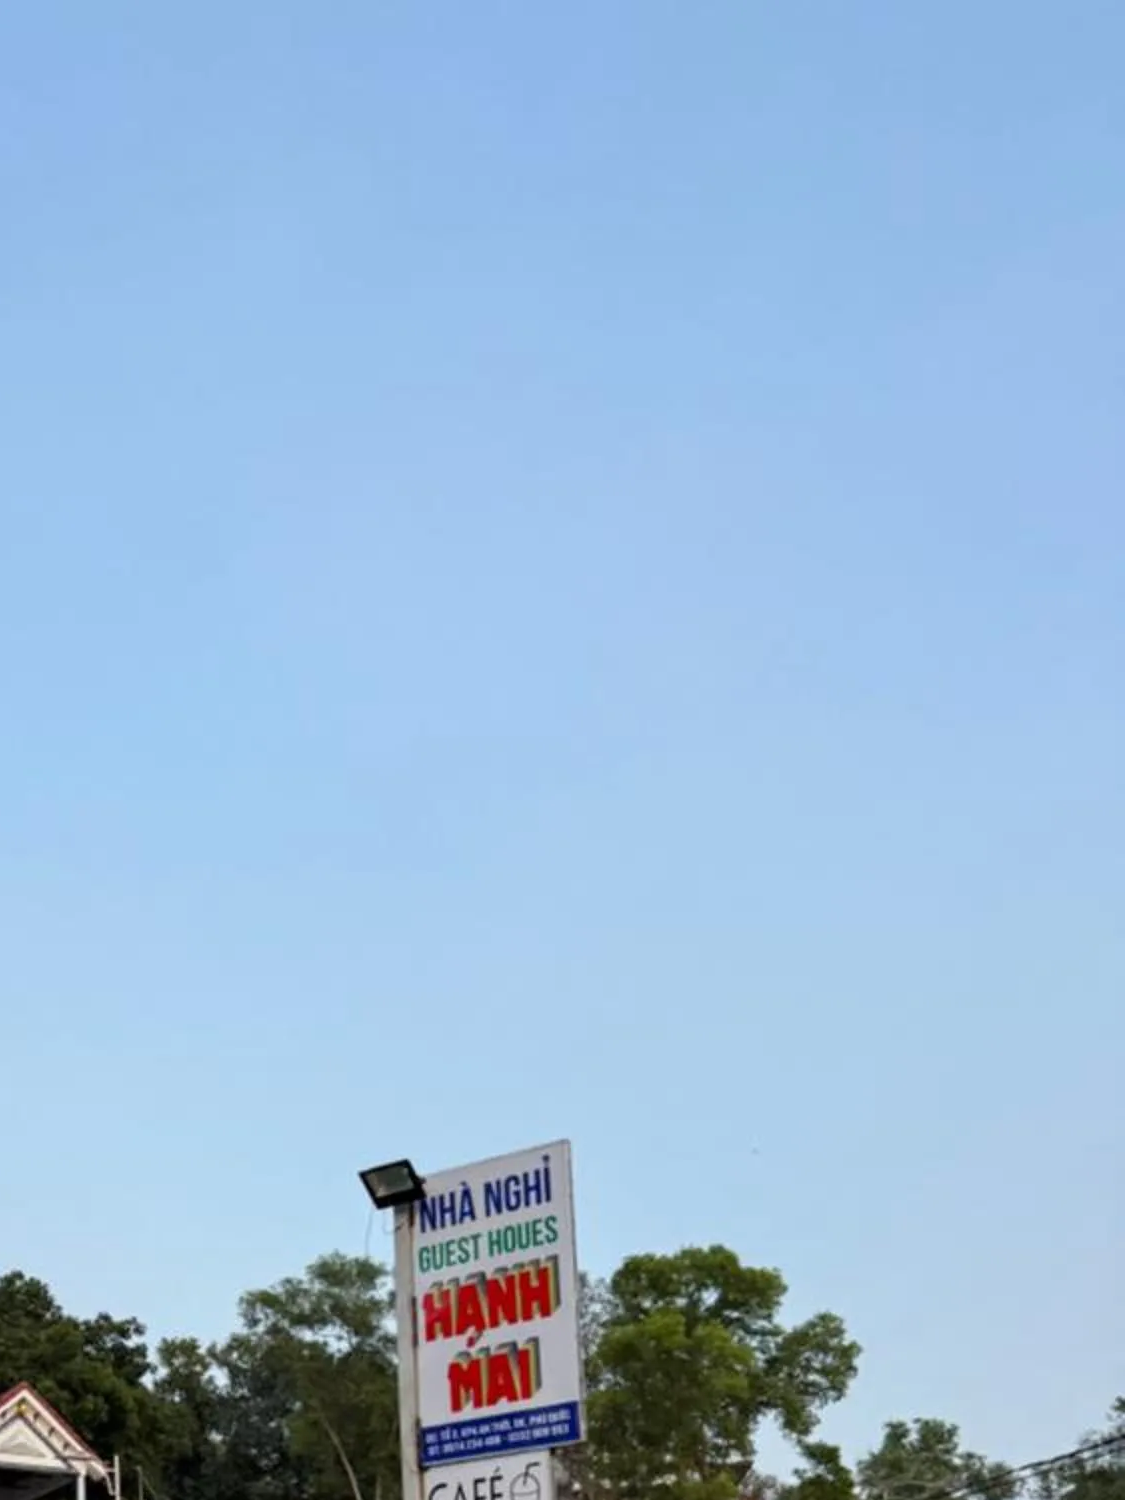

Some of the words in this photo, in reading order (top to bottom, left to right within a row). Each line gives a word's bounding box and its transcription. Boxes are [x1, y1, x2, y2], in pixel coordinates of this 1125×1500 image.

[419, 1181, 477, 1233] NHÀ
[418, 1232, 481, 1273] GUEST
[488, 1215, 558, 1257] HOUES
[447, 1341, 538, 1413] MAI
